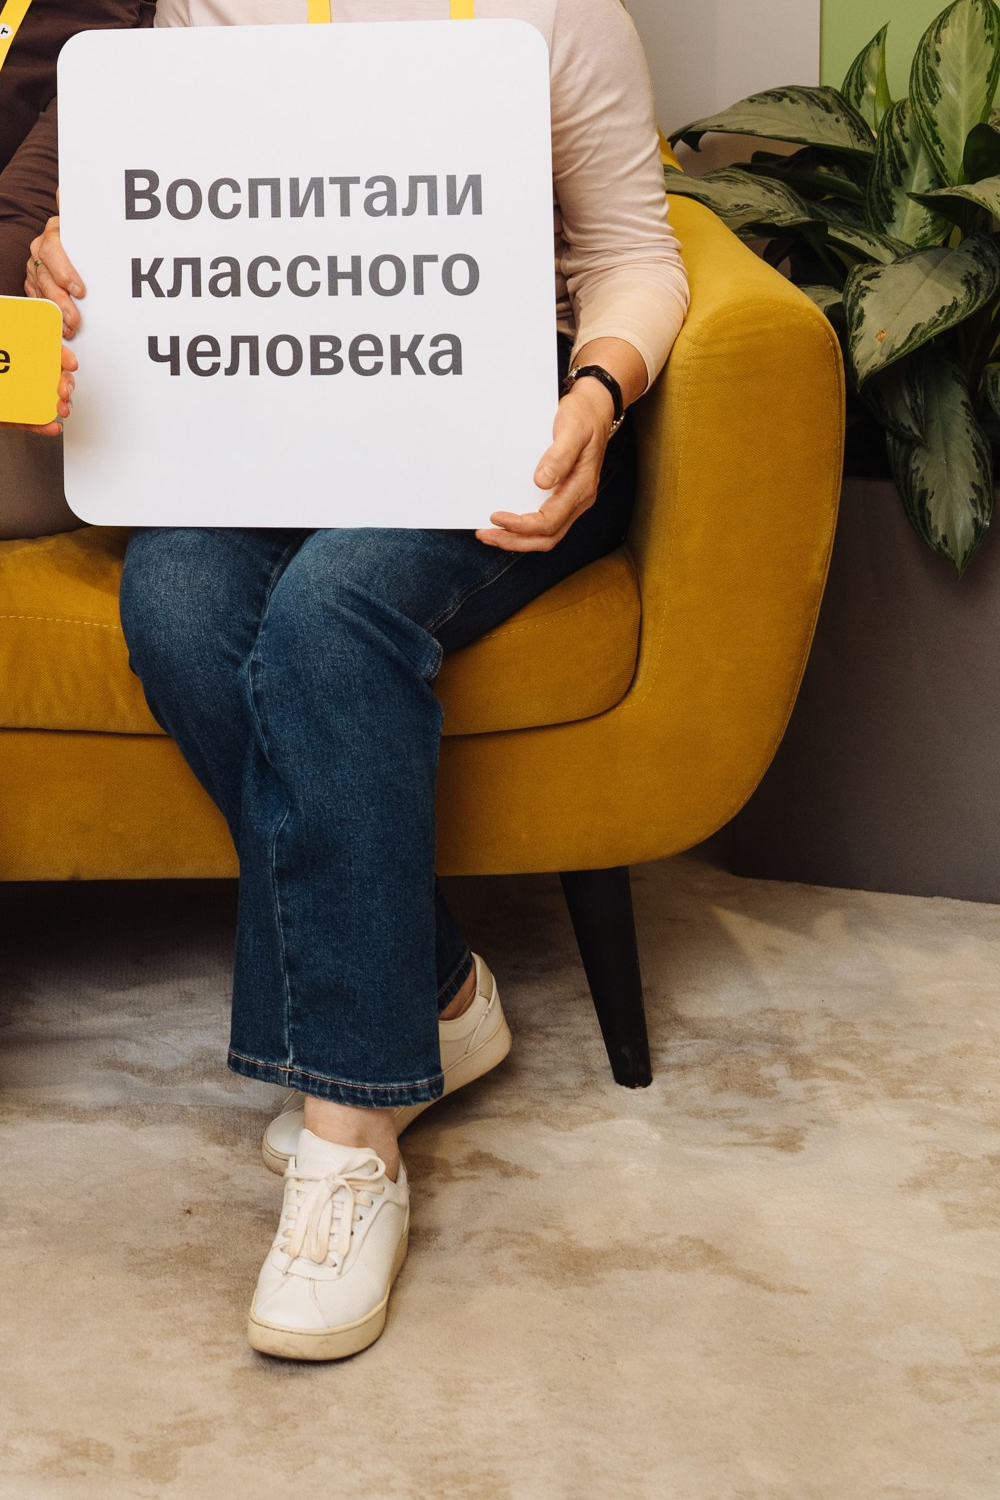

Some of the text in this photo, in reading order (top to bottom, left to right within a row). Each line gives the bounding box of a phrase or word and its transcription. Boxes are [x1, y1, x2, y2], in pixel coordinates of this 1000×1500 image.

[124, 169, 483, 221] Воспитали
[131, 253, 480, 299] классного
[147, 333, 463, 378] человека
